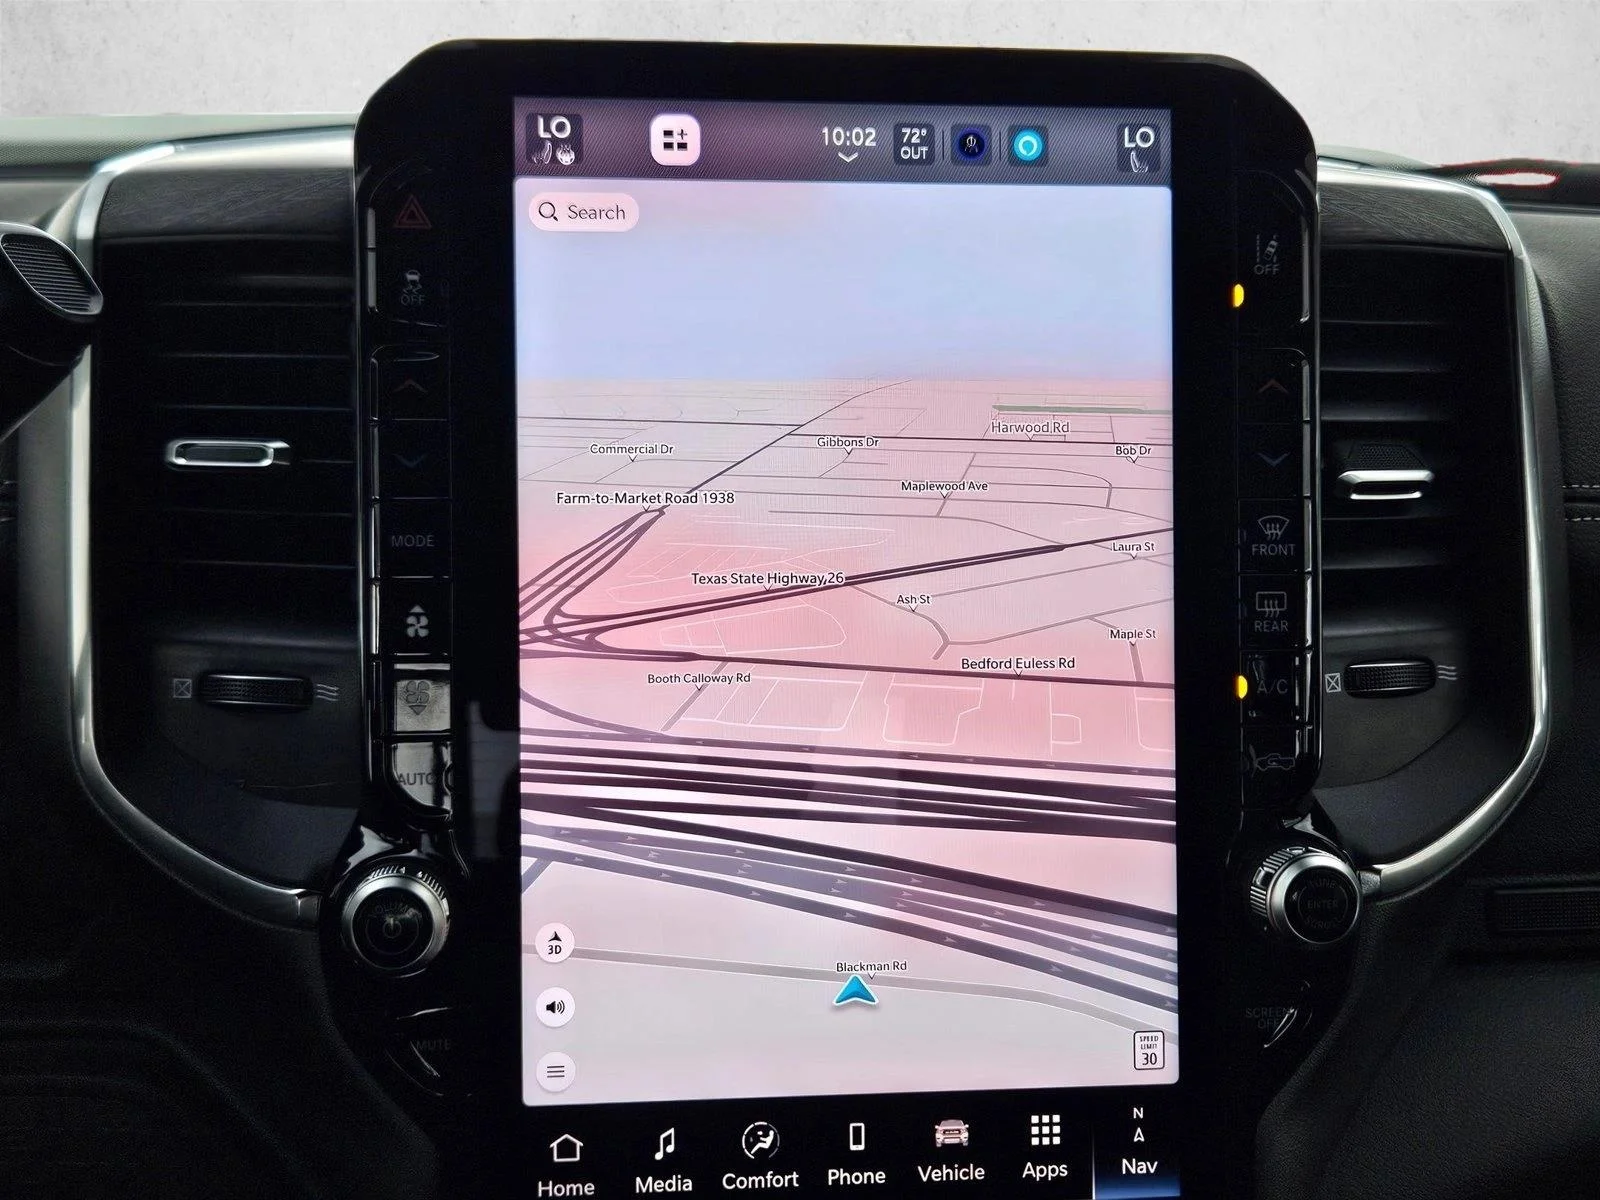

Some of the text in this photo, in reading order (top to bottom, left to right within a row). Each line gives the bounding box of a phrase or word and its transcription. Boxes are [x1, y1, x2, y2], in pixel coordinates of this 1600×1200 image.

[538, 115, 571, 139] LO
[822, 126, 877, 147] 10:02
[901, 127, 927, 144] 72°
[1124, 126, 1155, 148] LO
[900, 146, 928, 160] OUT
[568, 203, 626, 221] Search
[991, 421, 1070, 433] Harwood Rd
[590, 443, 674, 455] Commercial Dr
[817, 437, 879, 448] Gibbons Dr
[1115, 445, 1152, 456] Bob Dr
[901, 480, 989, 494] Maplewood Ave
[557, 491, 735, 505] Farm-to-Market Road 1938
[391, 534, 436, 548] MODE
[1112, 541, 1155, 552] Laura St
[1251, 543, 1296, 557] FRONT
[691, 571, 845, 587] Texas State Highway 26
[896, 594, 931, 605] Ash St
[1254, 620, 1288, 633] REAR
[1109, 628, 1157, 641] Maple St
[961, 657, 1075, 669] Bedford Euless Rd
[647, 672, 752, 685] Booth Calloway Rd
[1256, 679, 1289, 695] A/C
[548, 944, 562, 955] 3D
[836, 960, 907, 973] Blackman Rd
[1141, 1052, 1158, 1066] 30
[1133, 1107, 1144, 1119] N
[918, 1163, 985, 1183] Vehicle
[1022, 1161, 1068, 1181] Apps
[1121, 1158, 1158, 1175] Nav
[635, 1174, 693, 1194] Media
[721, 1170, 800, 1190] Comfort
[827, 1168, 887, 1186] Phone
[538, 1180, 595, 1198] Home
